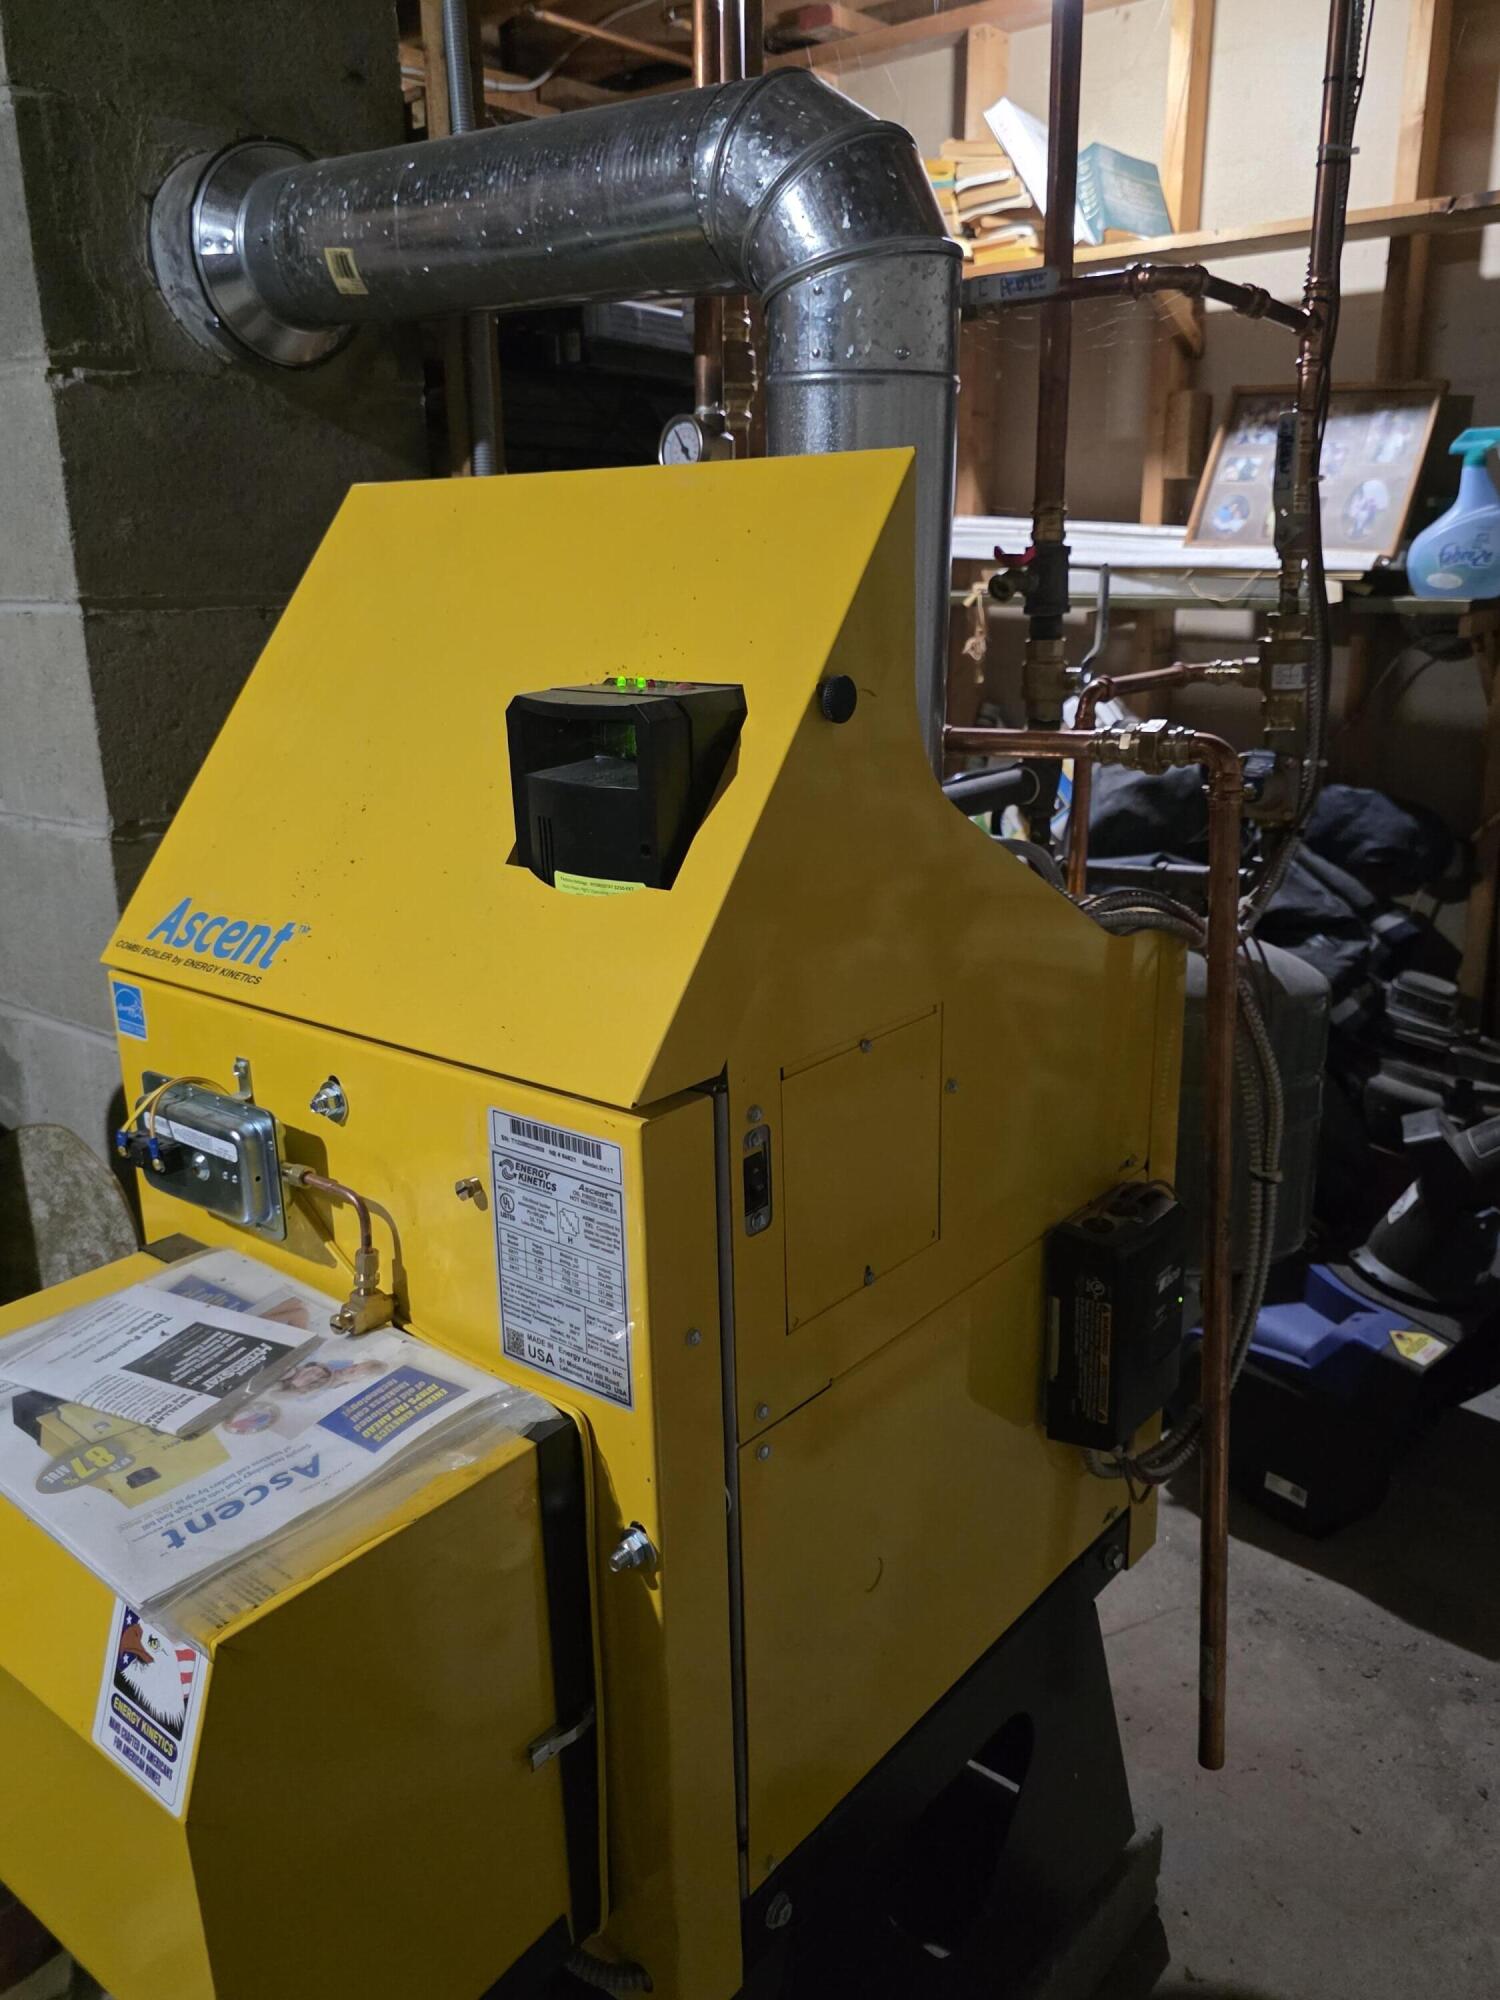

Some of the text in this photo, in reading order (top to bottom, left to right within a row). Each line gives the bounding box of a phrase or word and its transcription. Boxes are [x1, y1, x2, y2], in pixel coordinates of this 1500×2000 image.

[116, 940, 262, 985] COMBI BOILER by ENERGY KINETICS
[514, 1161, 550, 1180] ENERGY
[518, 1171, 557, 1192] KINETICS
[500, 1210, 515, 1221] LISTED
[569, 1194, 617, 1215] HOT WATER BOILER
[567, 1236, 572, 1244] H
[126, 1313, 162, 1336] Design
[141, 1316, 173, 1335] Three
[92, 1335, 140, 1364] Function
[526, 1332, 545, 1346] MADE
[546, 1340, 553, 1350] IN
[527, 1343, 554, 1367] USA
[558, 1345, 580, 1362] Energy
[582, 1355, 610, 1374] Kinetics,
[612, 1368, 624, 1379] Inc.
[593, 1370, 602, 1380] Hill
[604, 1375, 619, 1387] Road
[614, 1387, 626, 1397] USA
[361, 1383, 439, 1438] JUMPS FAR AHEAD
[372, 1388, 448, 1442] ENERGY KINETICS
[161, 1454, 320, 1550] Ascent
[114, 1696, 173, 1756] ENERGY KINETICS
[109, 1716, 173, 1780] HAND CRAFTED BY AMERICANS
[113, 1736, 161, 1786] FOR AMERICAN HOMES
